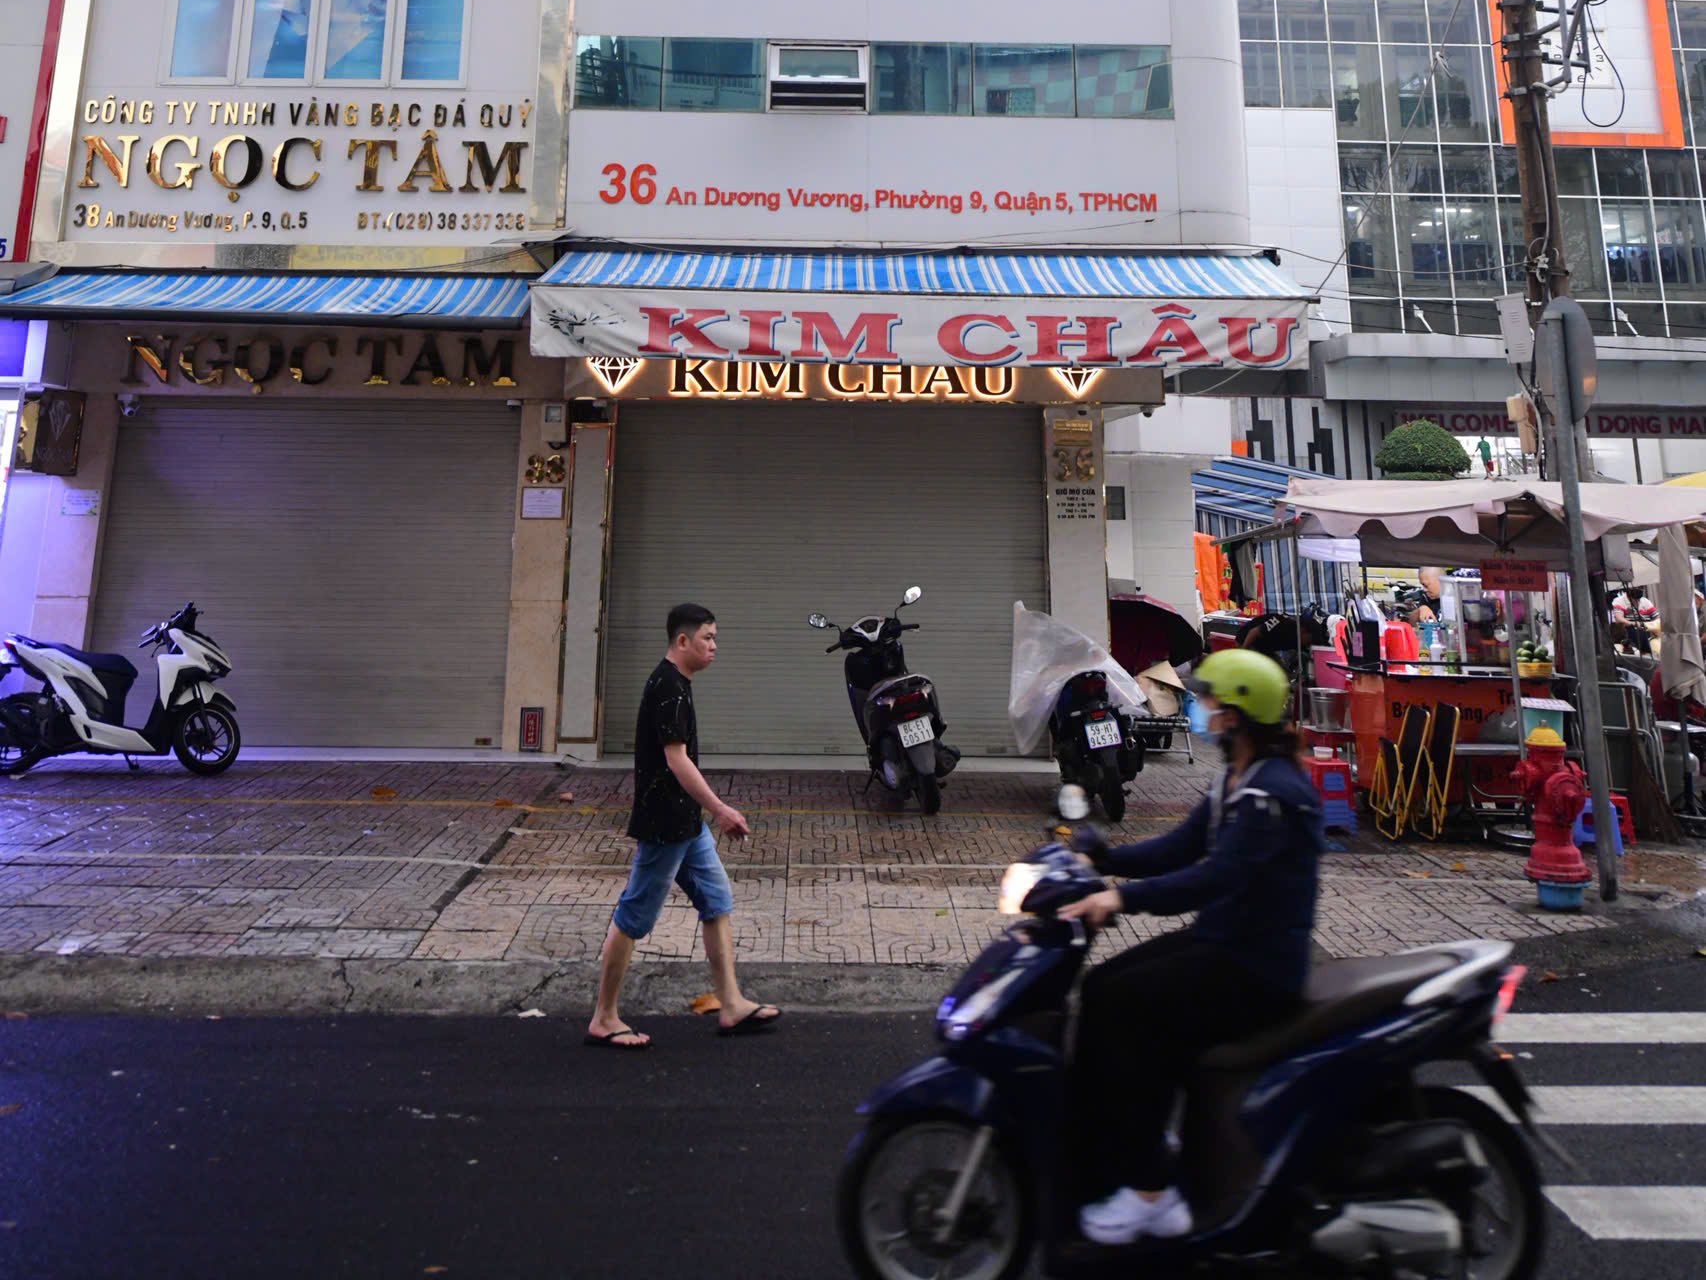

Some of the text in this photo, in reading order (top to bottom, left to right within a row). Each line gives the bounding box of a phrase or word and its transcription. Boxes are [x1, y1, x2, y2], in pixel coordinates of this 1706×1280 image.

[84, 95, 533, 132] CÔNG TY TNHH VÀNG BẠC ĐÁ QUÝ
[77, 129, 529, 203] NGỌC TÂM
[599, 163, 1158, 215] 36 An Dương Vương, Phường 9, Quận 5, TPHCM
[73, 203, 101, 228] 38
[637, 303, 1300, 368] KIM CHÂU
[120, 332, 337, 394] NGỌC
[669, 359, 804, 395] KIM
[1597, 416, 1662, 434] DONG
[1666, 416, 1706, 435] MA
